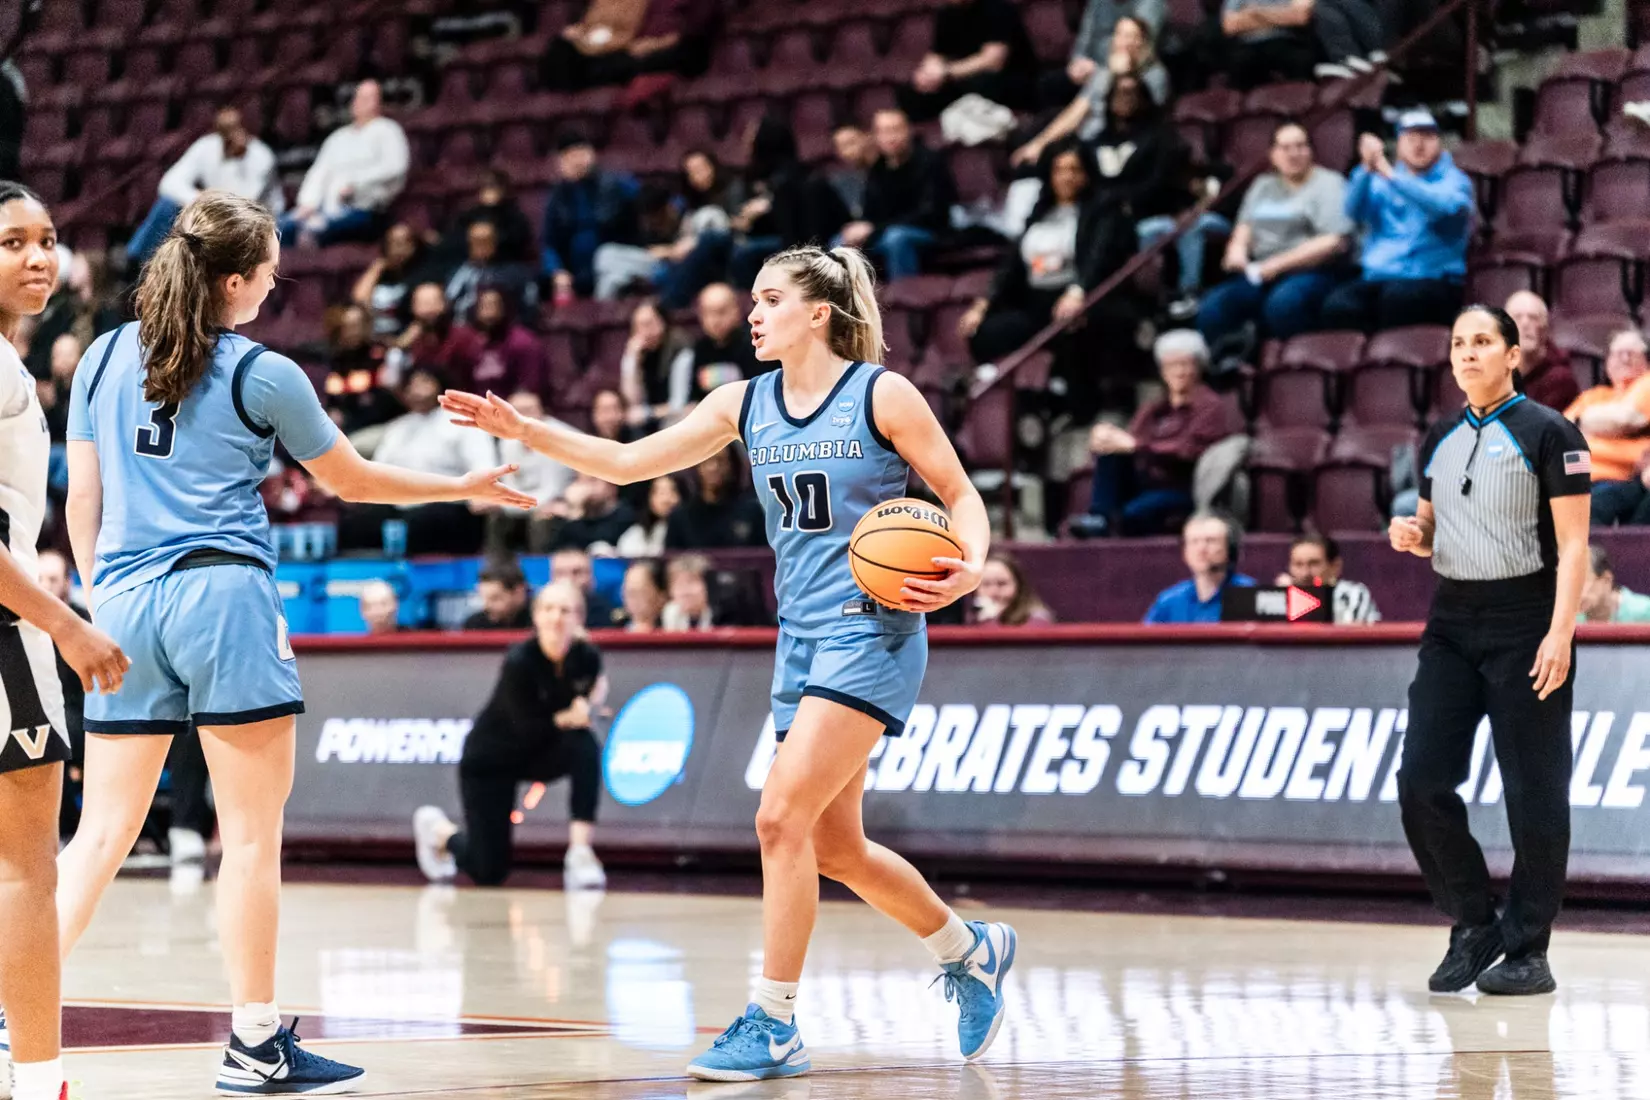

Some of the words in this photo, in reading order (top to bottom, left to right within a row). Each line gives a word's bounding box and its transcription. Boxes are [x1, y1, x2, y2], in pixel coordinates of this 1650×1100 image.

[134, 388, 181, 460] 3
[751, 439, 864, 467] COLUMBIA
[765, 469, 834, 533] 10
[876, 505, 951, 533] Wilson
[10, 723, 51, 760] V
[315, 717, 474, 764] POWERA
[745, 703, 1123, 794] BRATES
